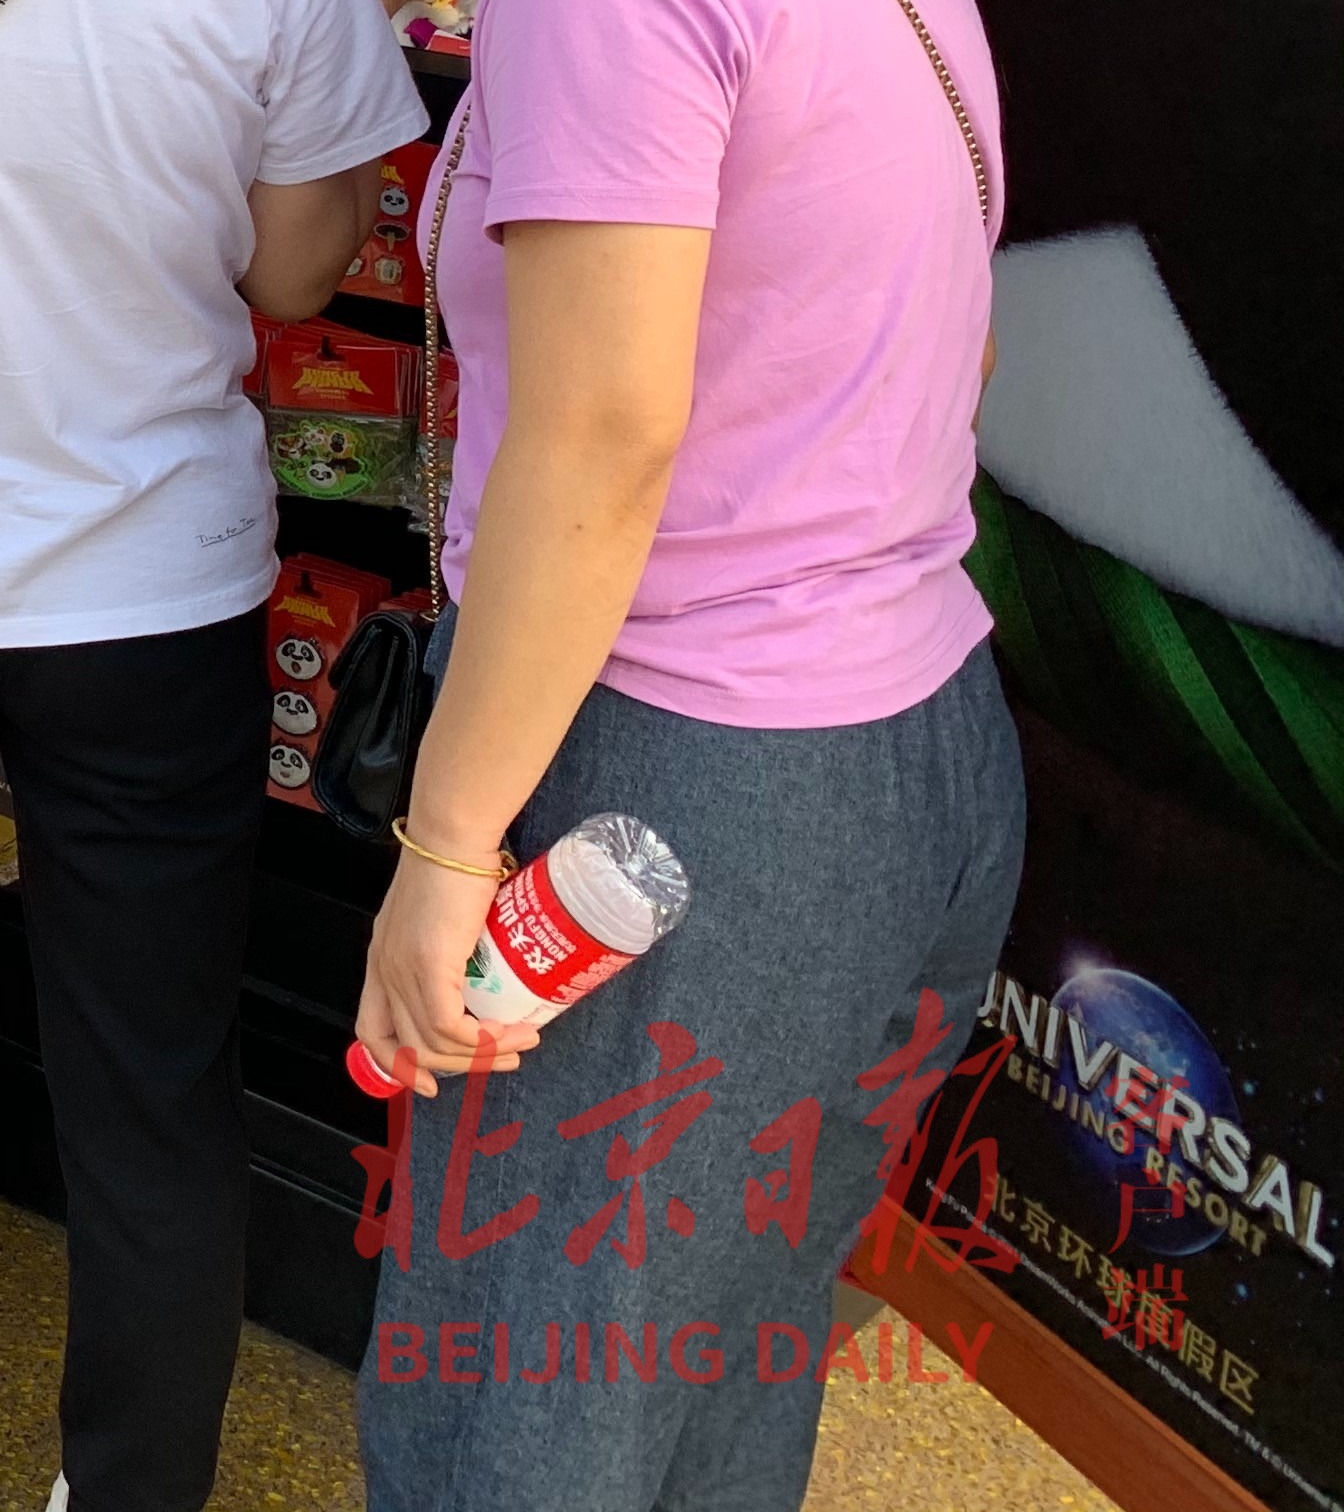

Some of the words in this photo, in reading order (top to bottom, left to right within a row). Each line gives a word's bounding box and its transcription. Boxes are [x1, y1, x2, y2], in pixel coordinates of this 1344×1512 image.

[525, 913, 569, 963] NONGFU
[1005, 1052, 1129, 1155] BEIJING
[1145, 1146, 1267, 1257] RESORT
